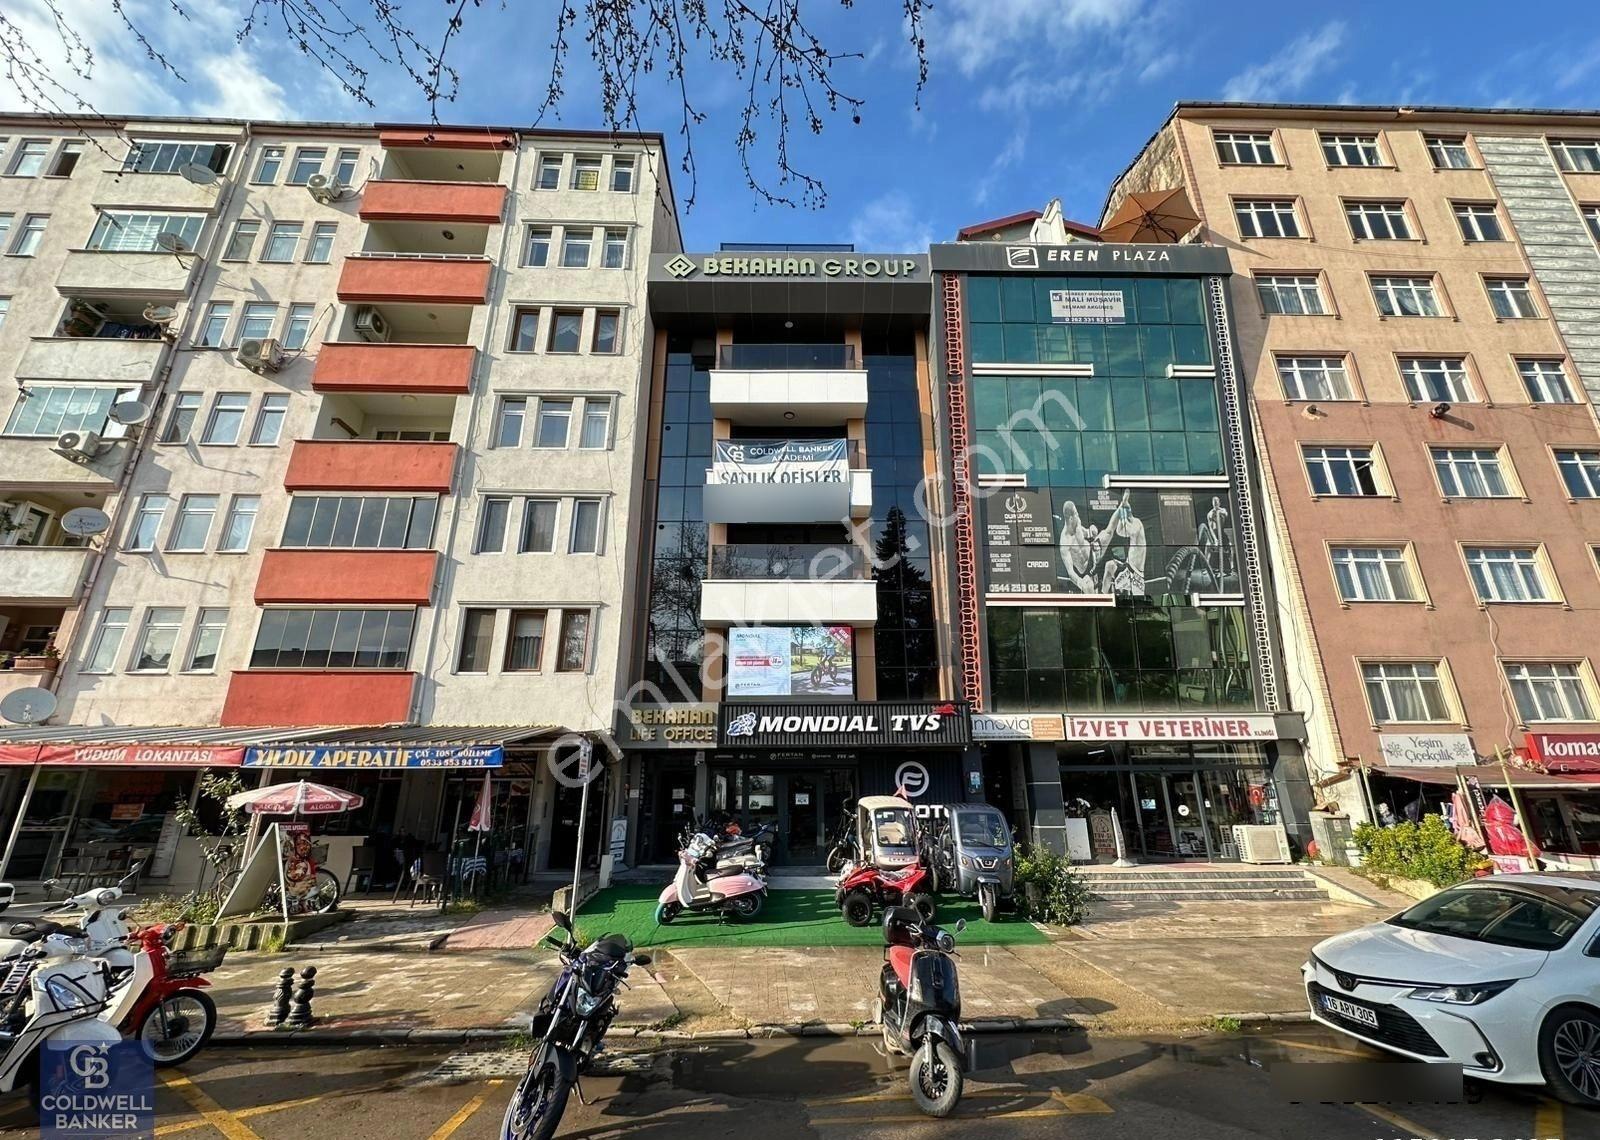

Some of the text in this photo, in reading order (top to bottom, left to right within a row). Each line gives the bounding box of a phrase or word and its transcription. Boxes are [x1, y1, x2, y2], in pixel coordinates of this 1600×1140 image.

[1047, 249, 1170, 261] EREN PLAZA
[703, 257, 916, 276] BEKAHAN GROUP
[750, 445, 834, 455] COLDWELL BANKER
[771, 453, 814, 462] AKADEMİ
[989, 584, 1010, 592] 0544
[1028, 584, 1039, 592] 02
[1040, 584, 1051, 592] 20
[631, 708, 713, 724] BEKAHAN
[759, 714, 941, 732] MONDIAL TVS
[1070, 717, 1128, 737] İZVET
[1138, 717, 1251, 737] VETERİNER
[630, 728, 713, 740] LIFE OFFICE
[1408, 737, 1443, 749] Yeşim
[1541, 736, 1600, 756] koma
[134, 749, 213, 762] LOKANTASI
[256, 748, 413, 767] YILDIZ APERATİF
[415, 749, 430, 759] ÇAY
[435, 750, 454, 758] TOST
[1405, 749, 1454, 763] Çiçekçilik
[1327, 997, 1338, 1010] 16
[1340, 1001, 1355, 1016] ARV
[1356, 1007, 1375, 1024] 305
